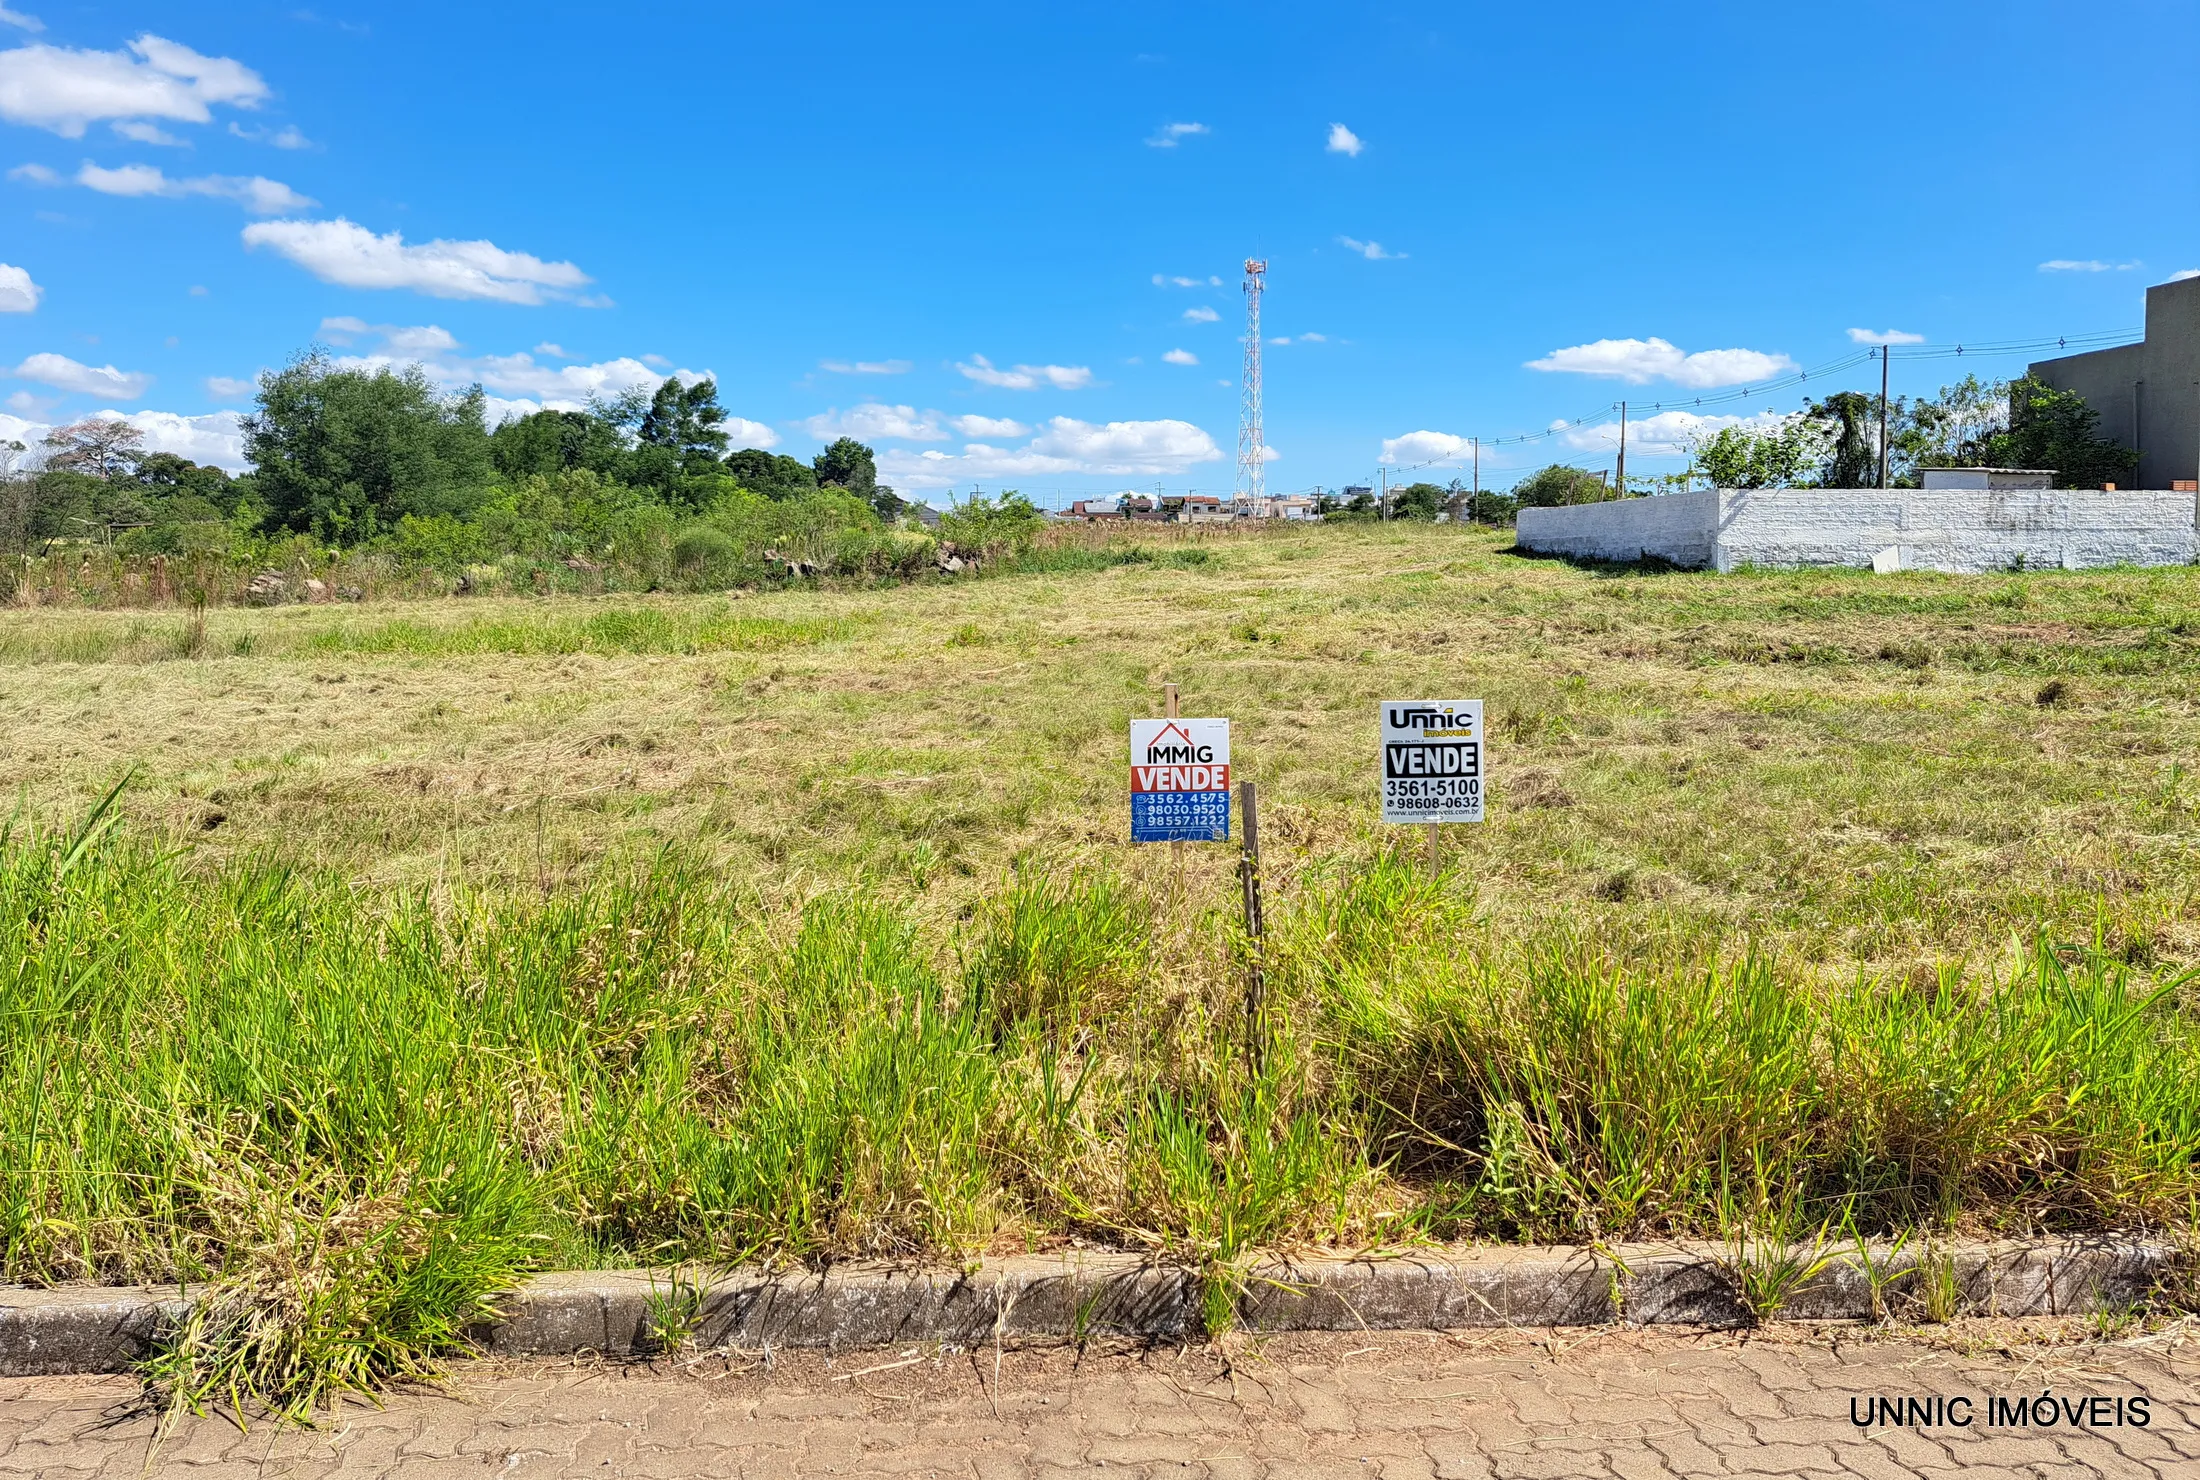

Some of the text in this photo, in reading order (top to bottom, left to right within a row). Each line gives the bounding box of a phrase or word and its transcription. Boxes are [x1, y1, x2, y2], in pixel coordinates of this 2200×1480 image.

[1147, 745, 1214, 764] IMMIG
[1389, 746, 1476, 775] VENDE
[1137, 766, 1225, 791] VENDE
[1386, 779, 1479, 797] 3561-5100
[1148, 793, 1225, 804] 3562.4575
[1397, 796, 1479, 809] 98608-0632
[1147, 804, 1225, 815] 98030.9520
[1147, 815, 1225, 826] 98557.1222
